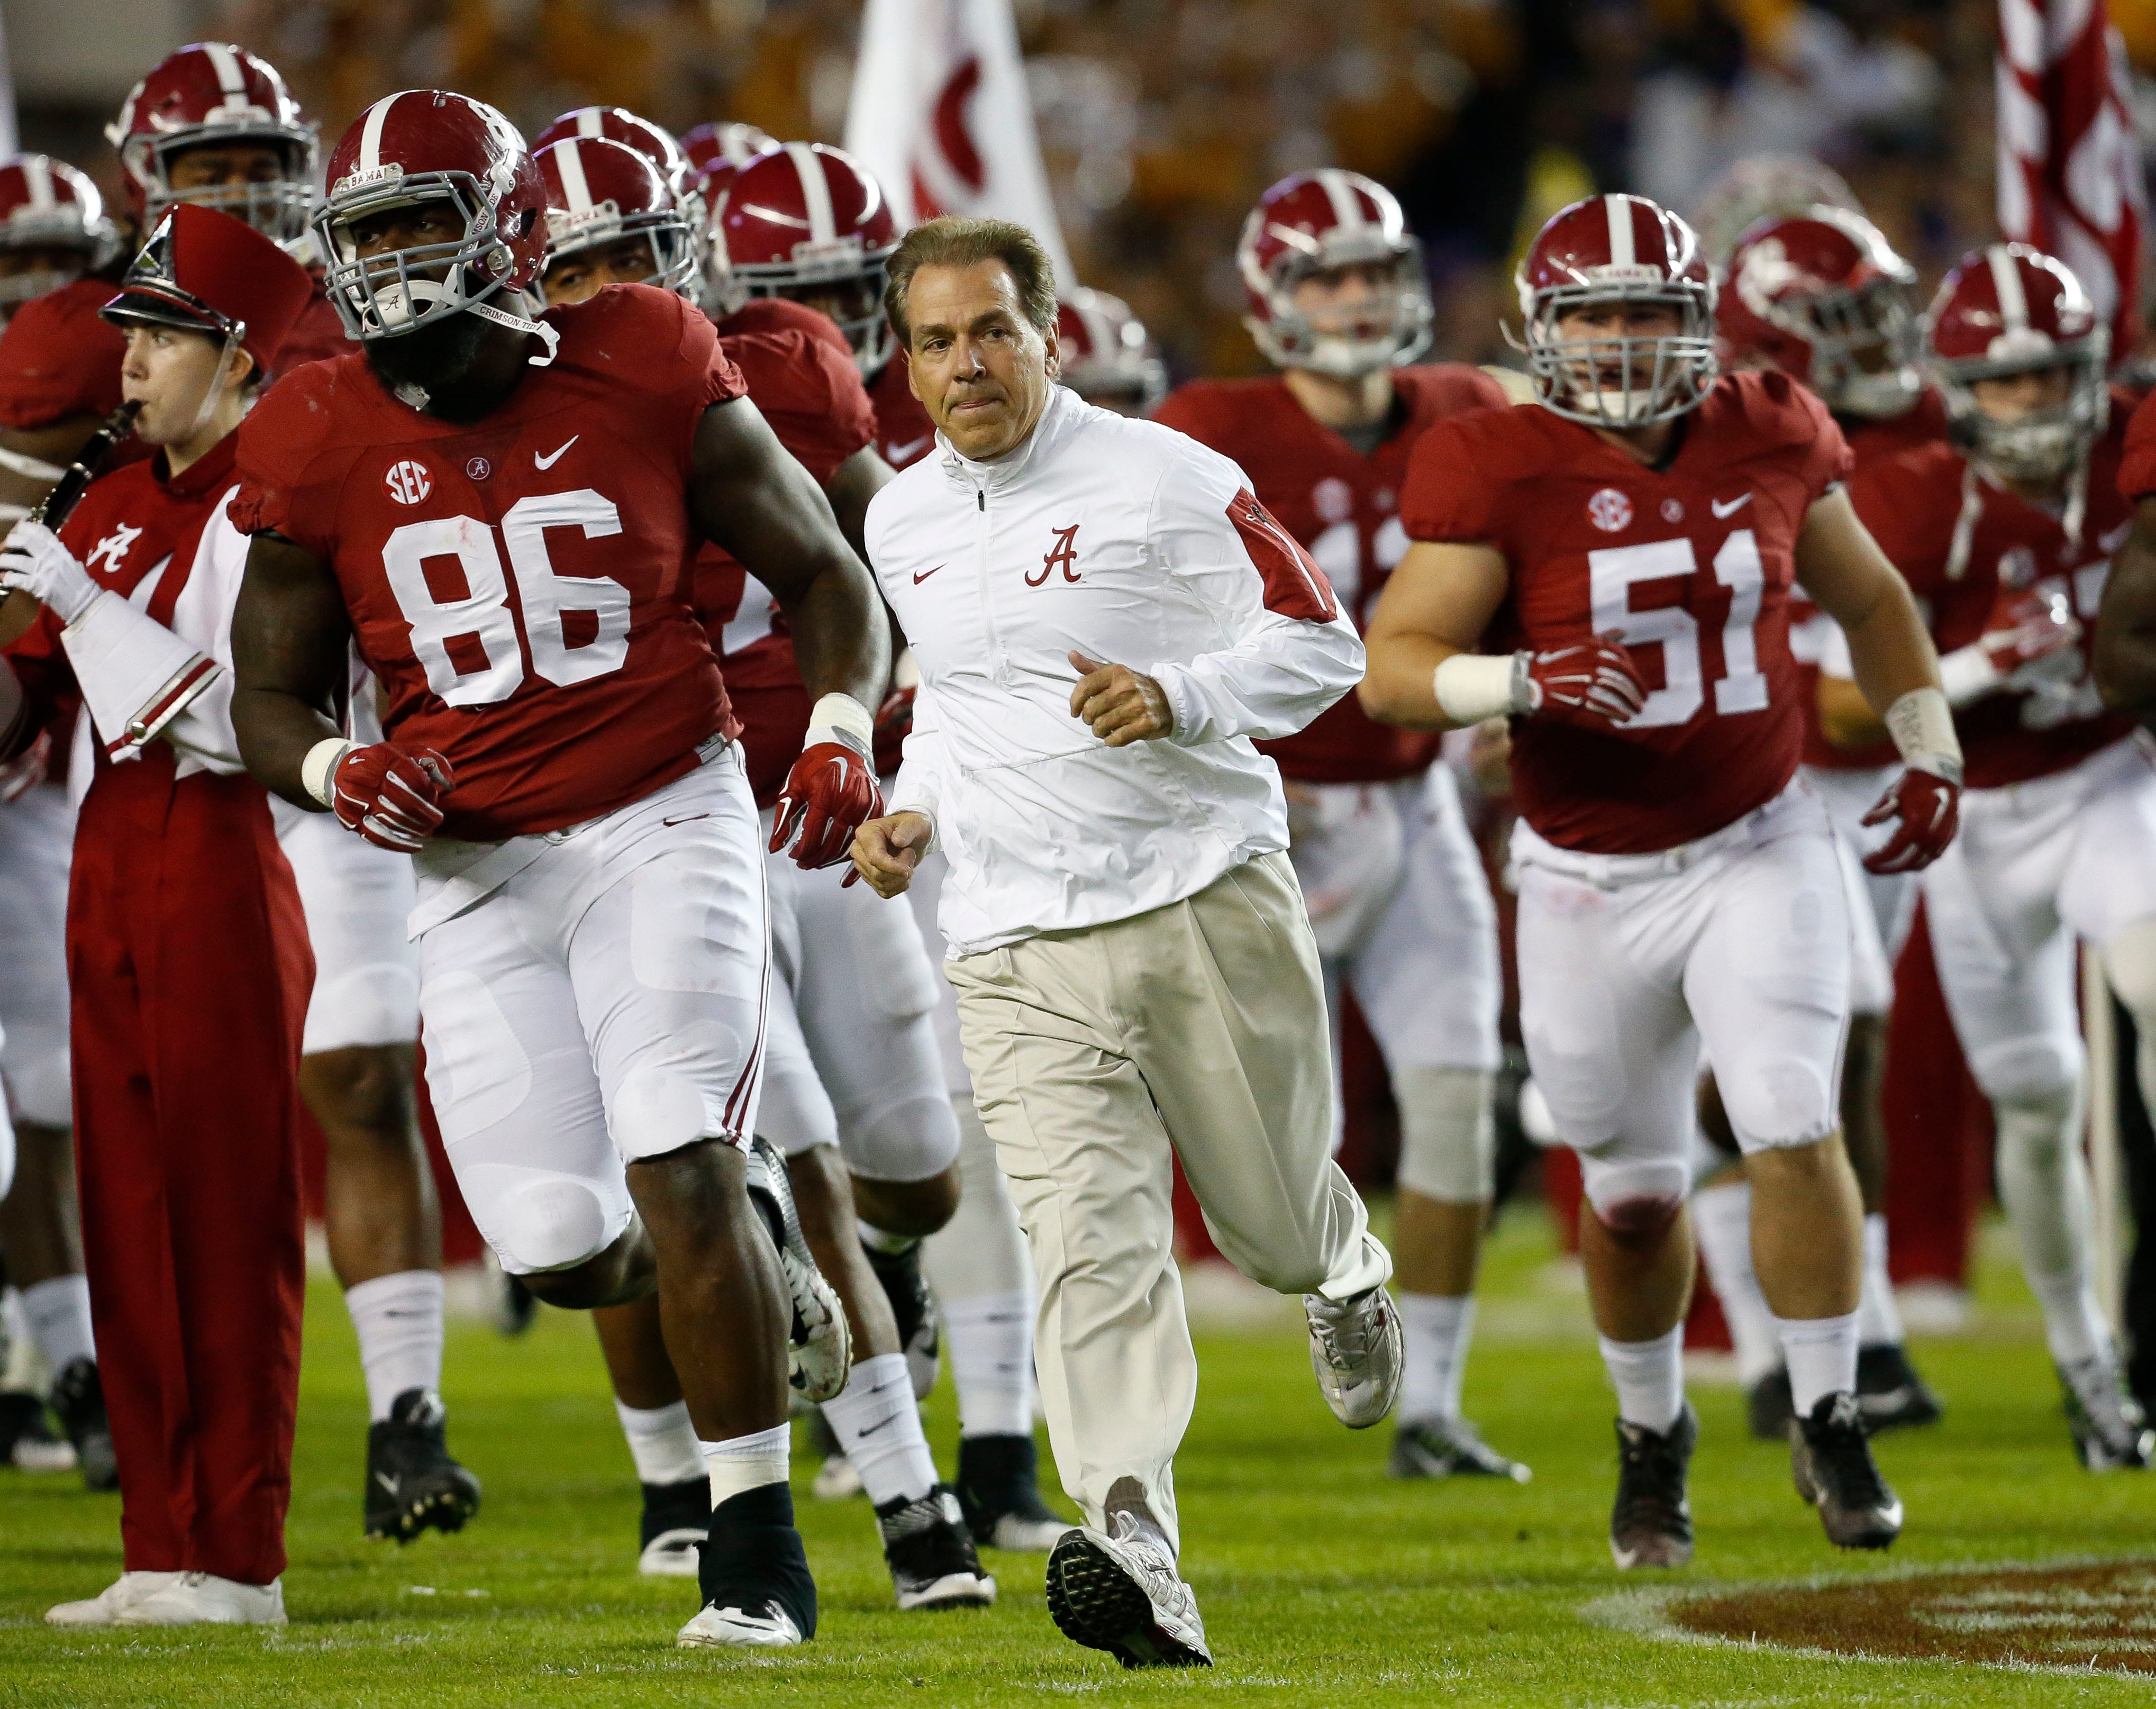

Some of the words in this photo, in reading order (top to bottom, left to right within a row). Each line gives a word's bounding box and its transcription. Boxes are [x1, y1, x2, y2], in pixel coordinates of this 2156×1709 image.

[351, 169, 383, 187] BAMA
[385, 294, 399, 311] A
[479, 305, 521, 326] CRIMSON
[521, 321, 536, 331] TID
[386, 460, 431, 505] SEC
[471, 460, 485, 477] A
[86, 521, 144, 573] A
[1024, 524, 1082, 587] A
[381, 488, 631, 708] 86
[1588, 528, 1771, 730] 51
